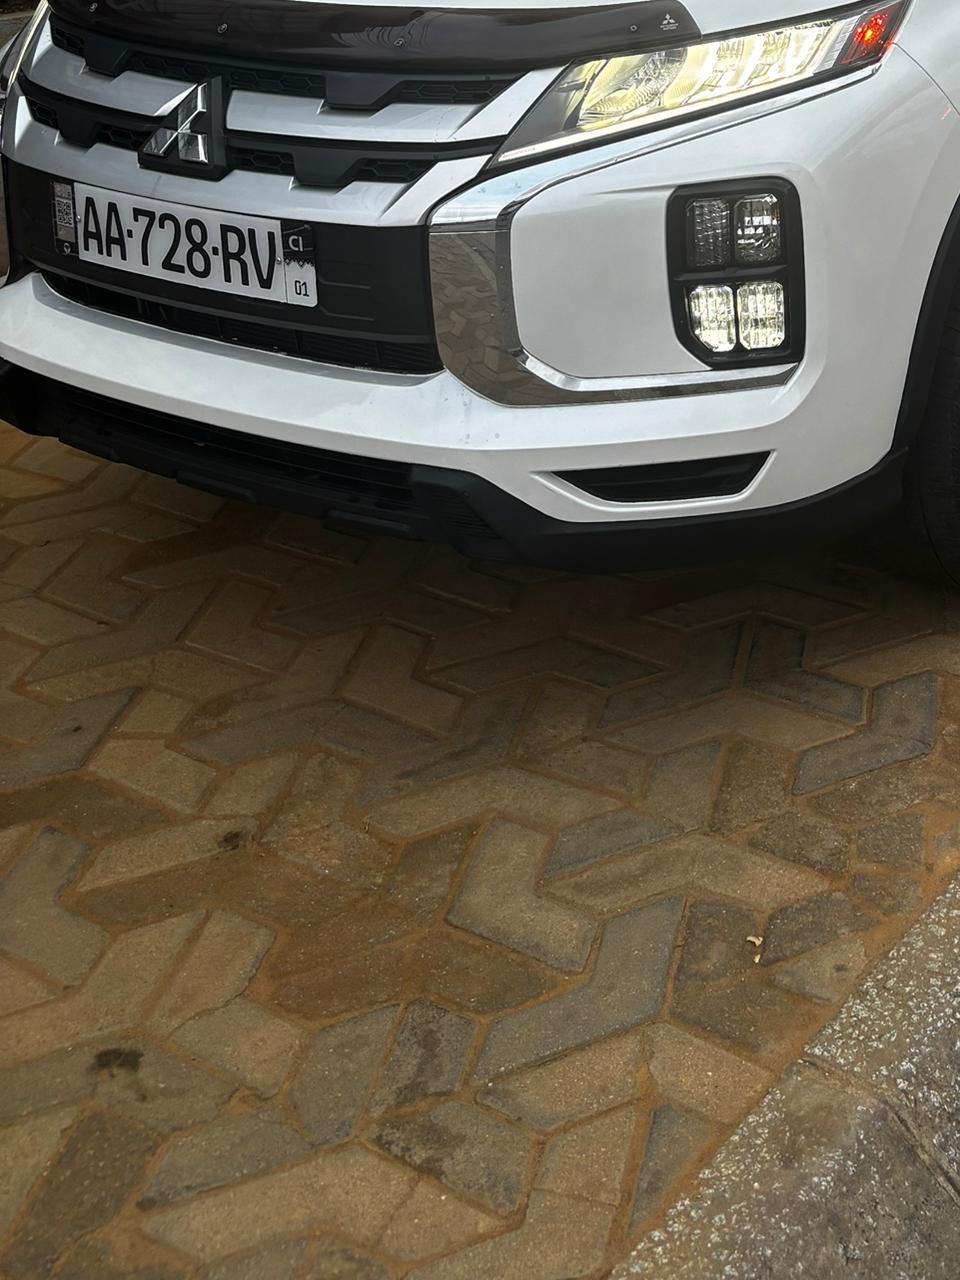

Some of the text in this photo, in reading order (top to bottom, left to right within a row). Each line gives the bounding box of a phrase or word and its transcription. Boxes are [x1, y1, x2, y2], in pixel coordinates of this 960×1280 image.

[82, 195, 277, 290] AA-728-RV
[288, 234, 305, 252] CI
[294, 279, 310, 297] 01
